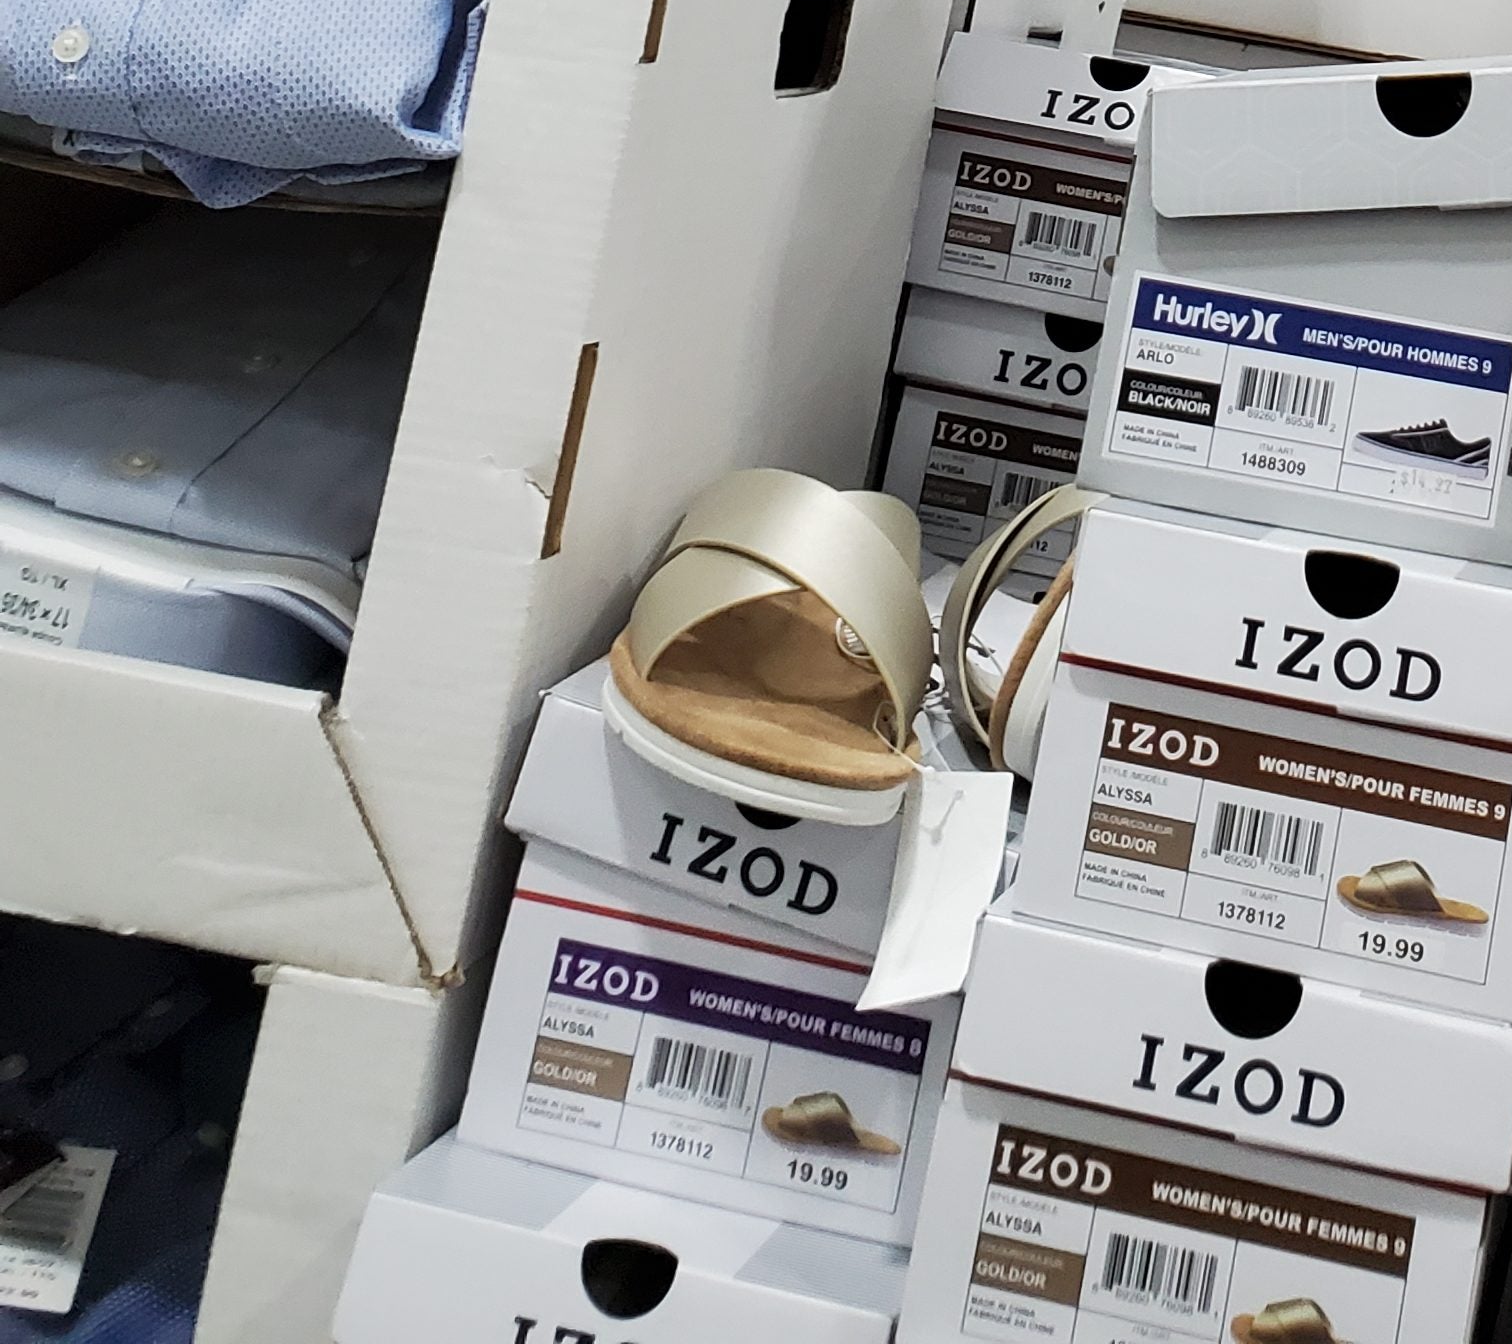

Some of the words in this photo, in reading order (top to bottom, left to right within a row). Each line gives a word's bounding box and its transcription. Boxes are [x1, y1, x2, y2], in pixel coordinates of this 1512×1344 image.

[1040, 89, 1135, 130] IZO
[960, 161, 1032, 191] IZOD
[1028, 271, 1072, 289] 1378112
[1153, 293, 1250, 338] Hurley
[1302, 327, 1403, 359] MEN'S/POUR
[1407, 345, 1479, 371] HOMMES
[1482, 359, 1492, 374] 9
[993, 349, 1088, 396] IZO
[1136, 349, 1175, 365] ARLO
[1128, 391, 1211, 417] BLACK/NOIR
[936, 421, 1008, 451] IZOD
[1032, 443, 1081, 462] WOMEN
[1242, 452, 1306, 476] 1488309
[1234, 616, 1443, 702] IZOD
[1107, 718, 1220, 767] IZOD
[1258, 754, 1404, 800] WOMEN'S/POUR
[1409, 786, 1489, 818] FEMMES
[1494, 804, 1506, 821] 9
[1097, 783, 1153, 806] ALYSSA
[1088, 828, 1158, 855] GOLD/OR
[650, 812, 839, 916] IZOD
[1218, 901, 1286, 930] 1378112
[1358, 931, 1425, 963] 19.99
[554, 954, 660, 1002] IZOD
[689, 989, 826, 1035] WOMEN'S/POUR
[830, 1021, 906, 1053] FEMMES
[909, 1038, 923, 1057] 8
[543, 1016, 595, 1039] ALYSSA
[1132, 1033, 1345, 1128] IZOD
[650, 1131, 713, 1159] 1378112
[786, 1159, 848, 1191] 19.99
[996, 1139, 1112, 1195] IZOD
[1152, 1180, 1301, 1233] WOMEN'S/POUR
[1307, 1217, 1388, 1253] FEMMES
[1393, 1237, 1406, 1257] 9
[985, 1210, 1043, 1237] ALYSSA
[975, 1260, 1047, 1290] GOLD/OR
